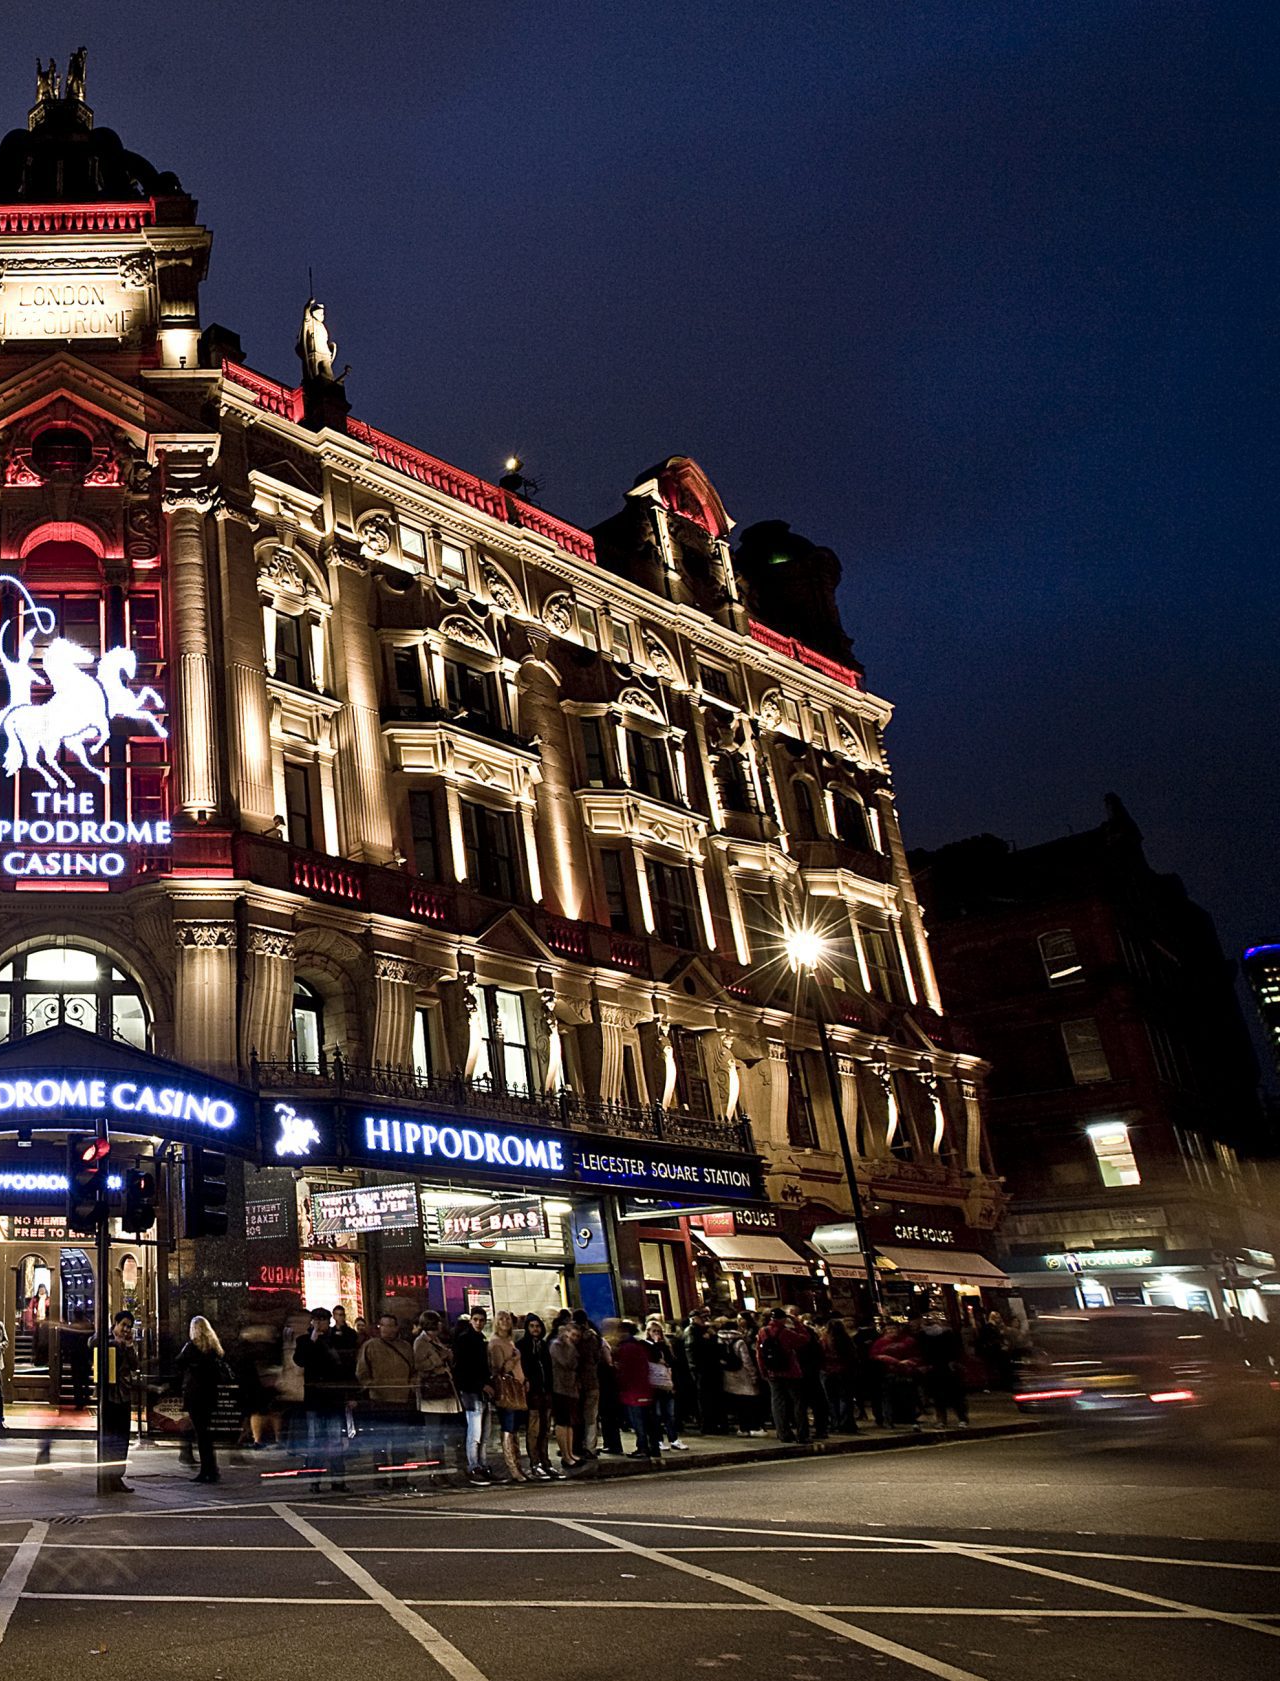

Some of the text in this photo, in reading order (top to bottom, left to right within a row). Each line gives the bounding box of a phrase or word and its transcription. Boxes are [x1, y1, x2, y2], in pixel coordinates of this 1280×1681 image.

[18, 283, 105, 306] LONDON
[31, 791, 95, 814] THE
[2, 852, 125, 876] CASINO
[112, 1082, 237, 1129] CASINO
[364, 1116, 566, 1172] HIPPODROME
[580, 1152, 751, 1188] LEICESTER SQUARE STATION
[320, 1194, 355, 1207] TWENTY
[382, 1189, 408, 1201] HOUR
[321, 1200, 408, 1219] TEXAS HOLD'EM
[735, 1210, 777, 1226] ROUGE
[14, 1216, 31, 1225] NO
[345, 1215, 382, 1228] POKER
[444, 1210, 539, 1234] FIVE BARS
[14, 1228, 46, 1238] FREE
[49, 1228, 65, 1238] TO
[921, 1228, 955, 1243] ROUGE
